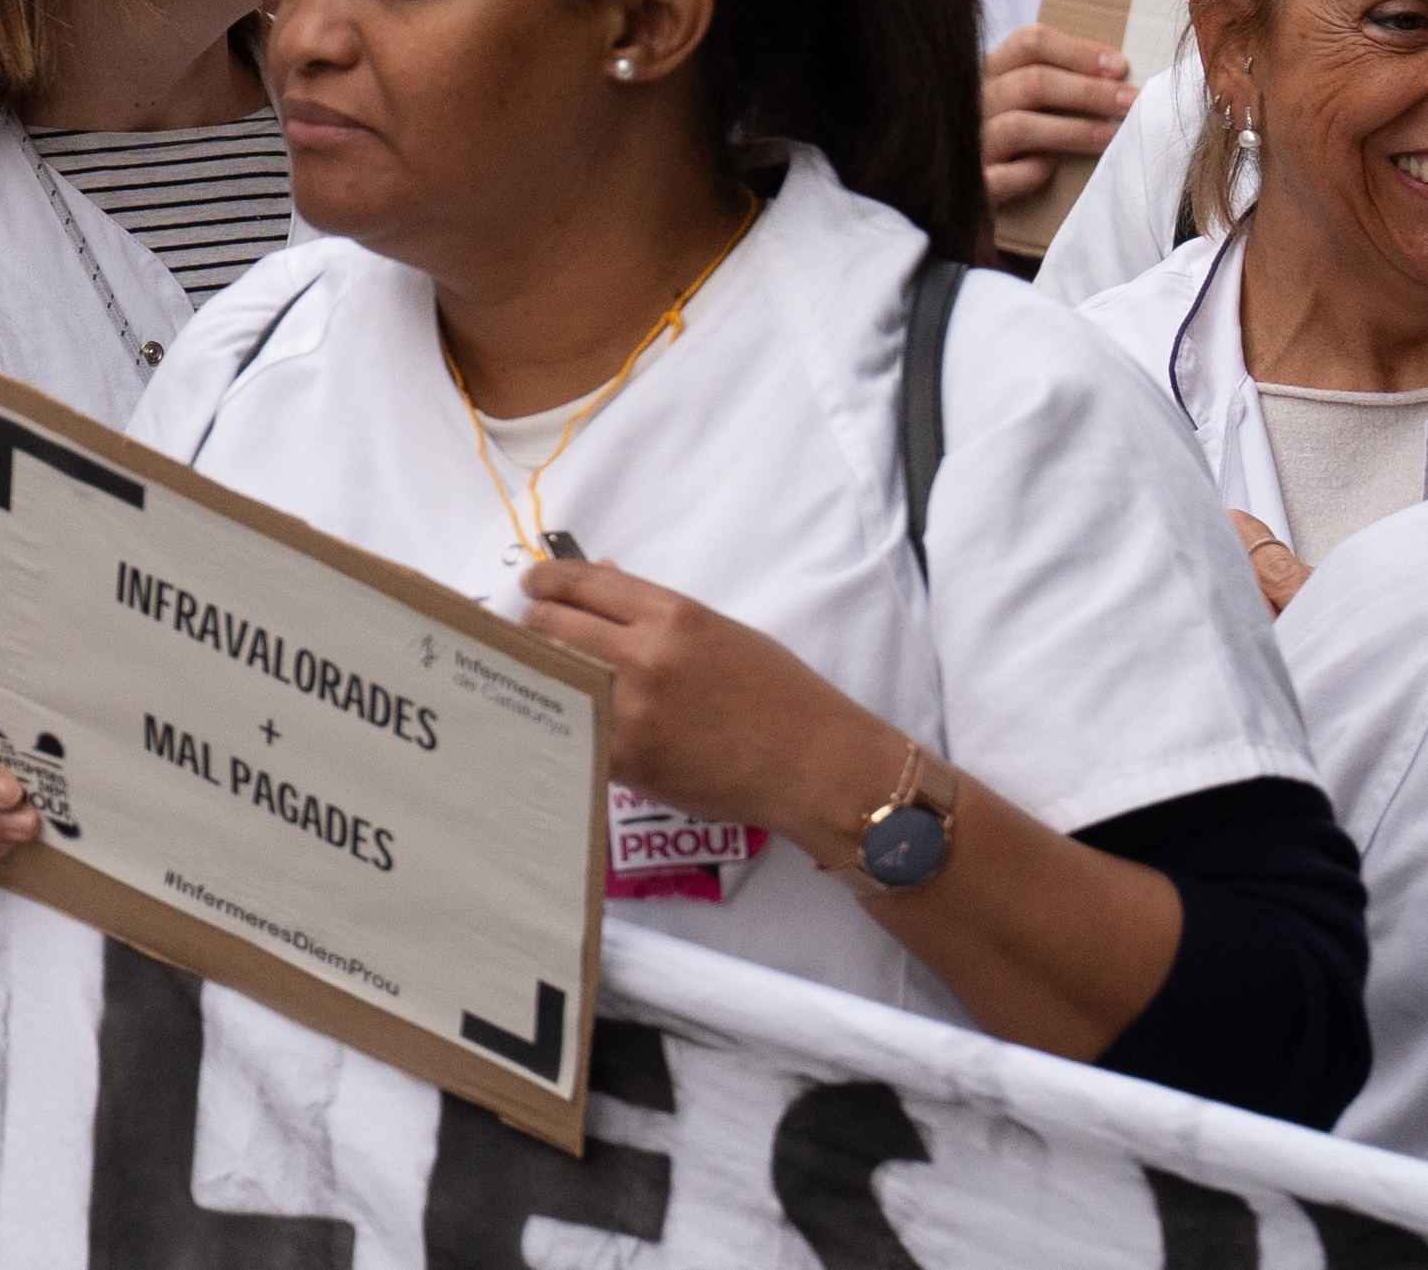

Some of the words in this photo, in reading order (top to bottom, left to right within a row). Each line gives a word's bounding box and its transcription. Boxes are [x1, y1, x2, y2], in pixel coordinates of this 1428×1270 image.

[115, 559, 440, 753] INFRAVALORADES
[143, 711, 221, 788] MAL
[228, 755, 397, 874] PAGADES
[258, 717, 283, 746] +
[620, 824, 744, 862] PROU!
[163, 868, 402, 999] #InfermeresDiemProu
